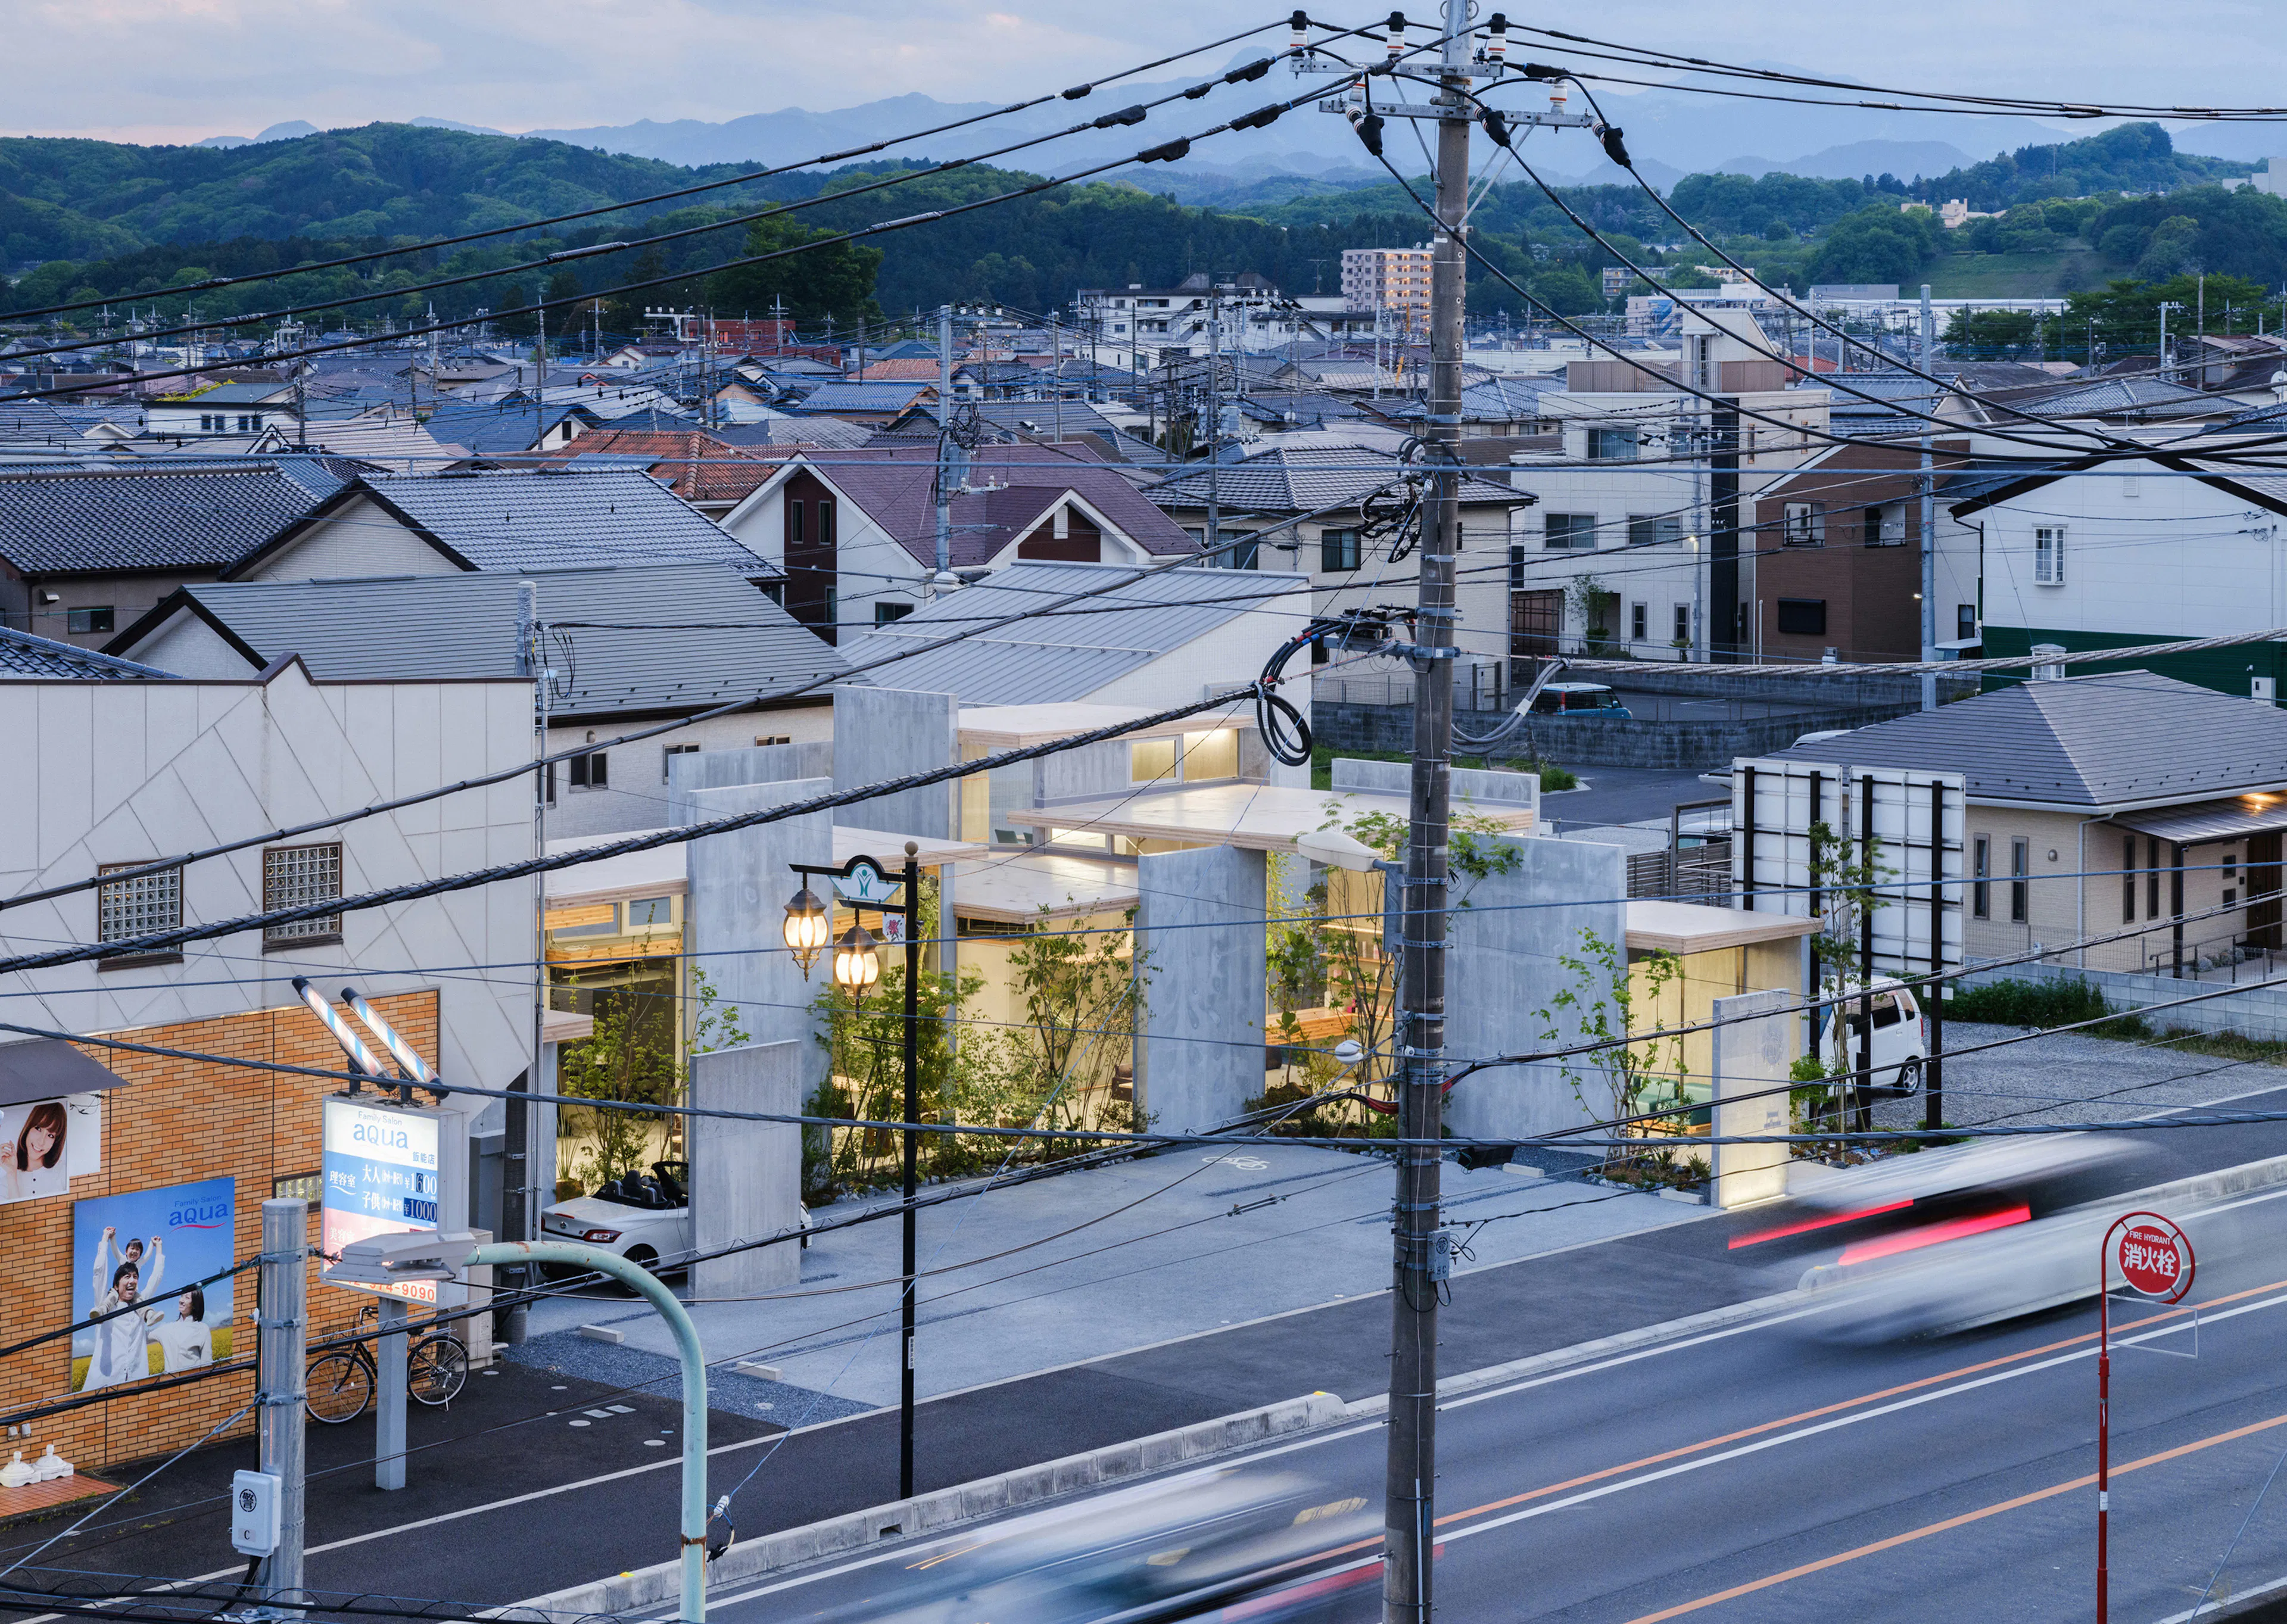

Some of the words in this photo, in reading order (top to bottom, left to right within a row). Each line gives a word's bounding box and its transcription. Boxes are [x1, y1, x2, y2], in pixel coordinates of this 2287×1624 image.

[358, 1111, 381, 1123] Family
[382, 1114, 403, 1126] Salon
[412, 1151, 435, 1165] 飯能店
[329, 1170, 356, 1188] 理容室
[362, 1164, 381, 1184] 大人
[175, 1198, 200, 1207] Family
[200, 1195, 222, 1203] Salon
[362, 1190, 381, 1211] 子供
[2129, 1230, 2142, 1240] FIRE
[2143, 1233, 2171, 1245] HYDRANT
[2124, 1242, 2176, 1277] 消火栓
[244, 1529, 250, 1540] C
